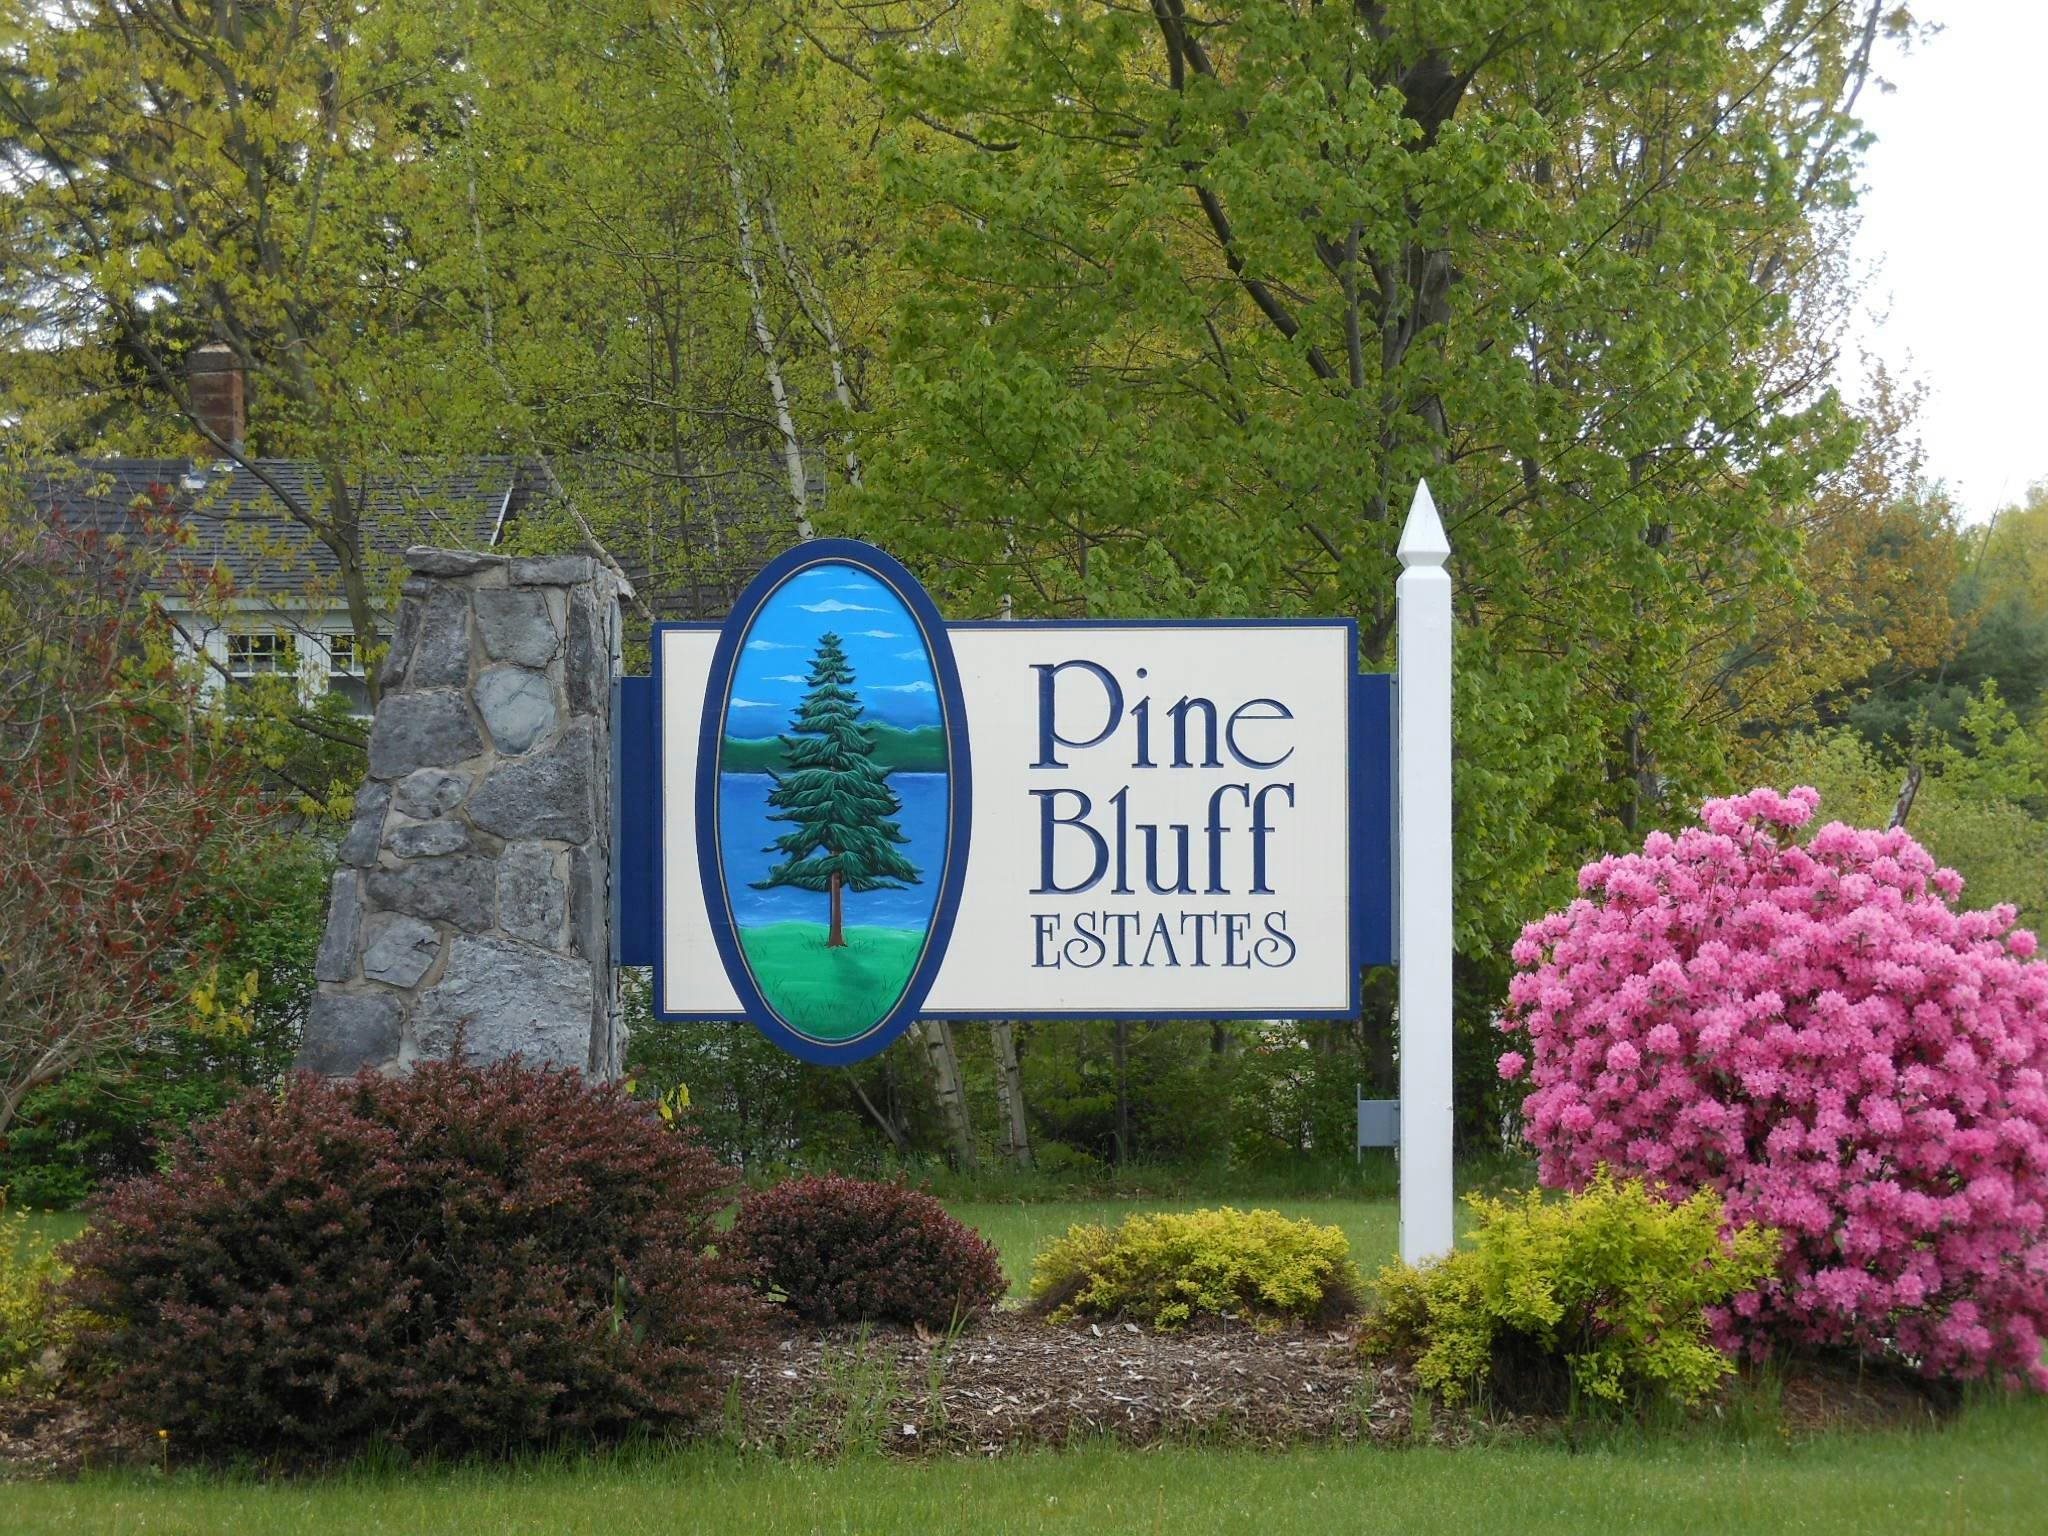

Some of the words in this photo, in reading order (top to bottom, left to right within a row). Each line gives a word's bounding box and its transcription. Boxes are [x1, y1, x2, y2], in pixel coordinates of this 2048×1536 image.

[1029, 659, 1295, 770] Pine
[1029, 782, 1295, 896] Bluff
[1030, 909, 1297, 970] ESTATES
